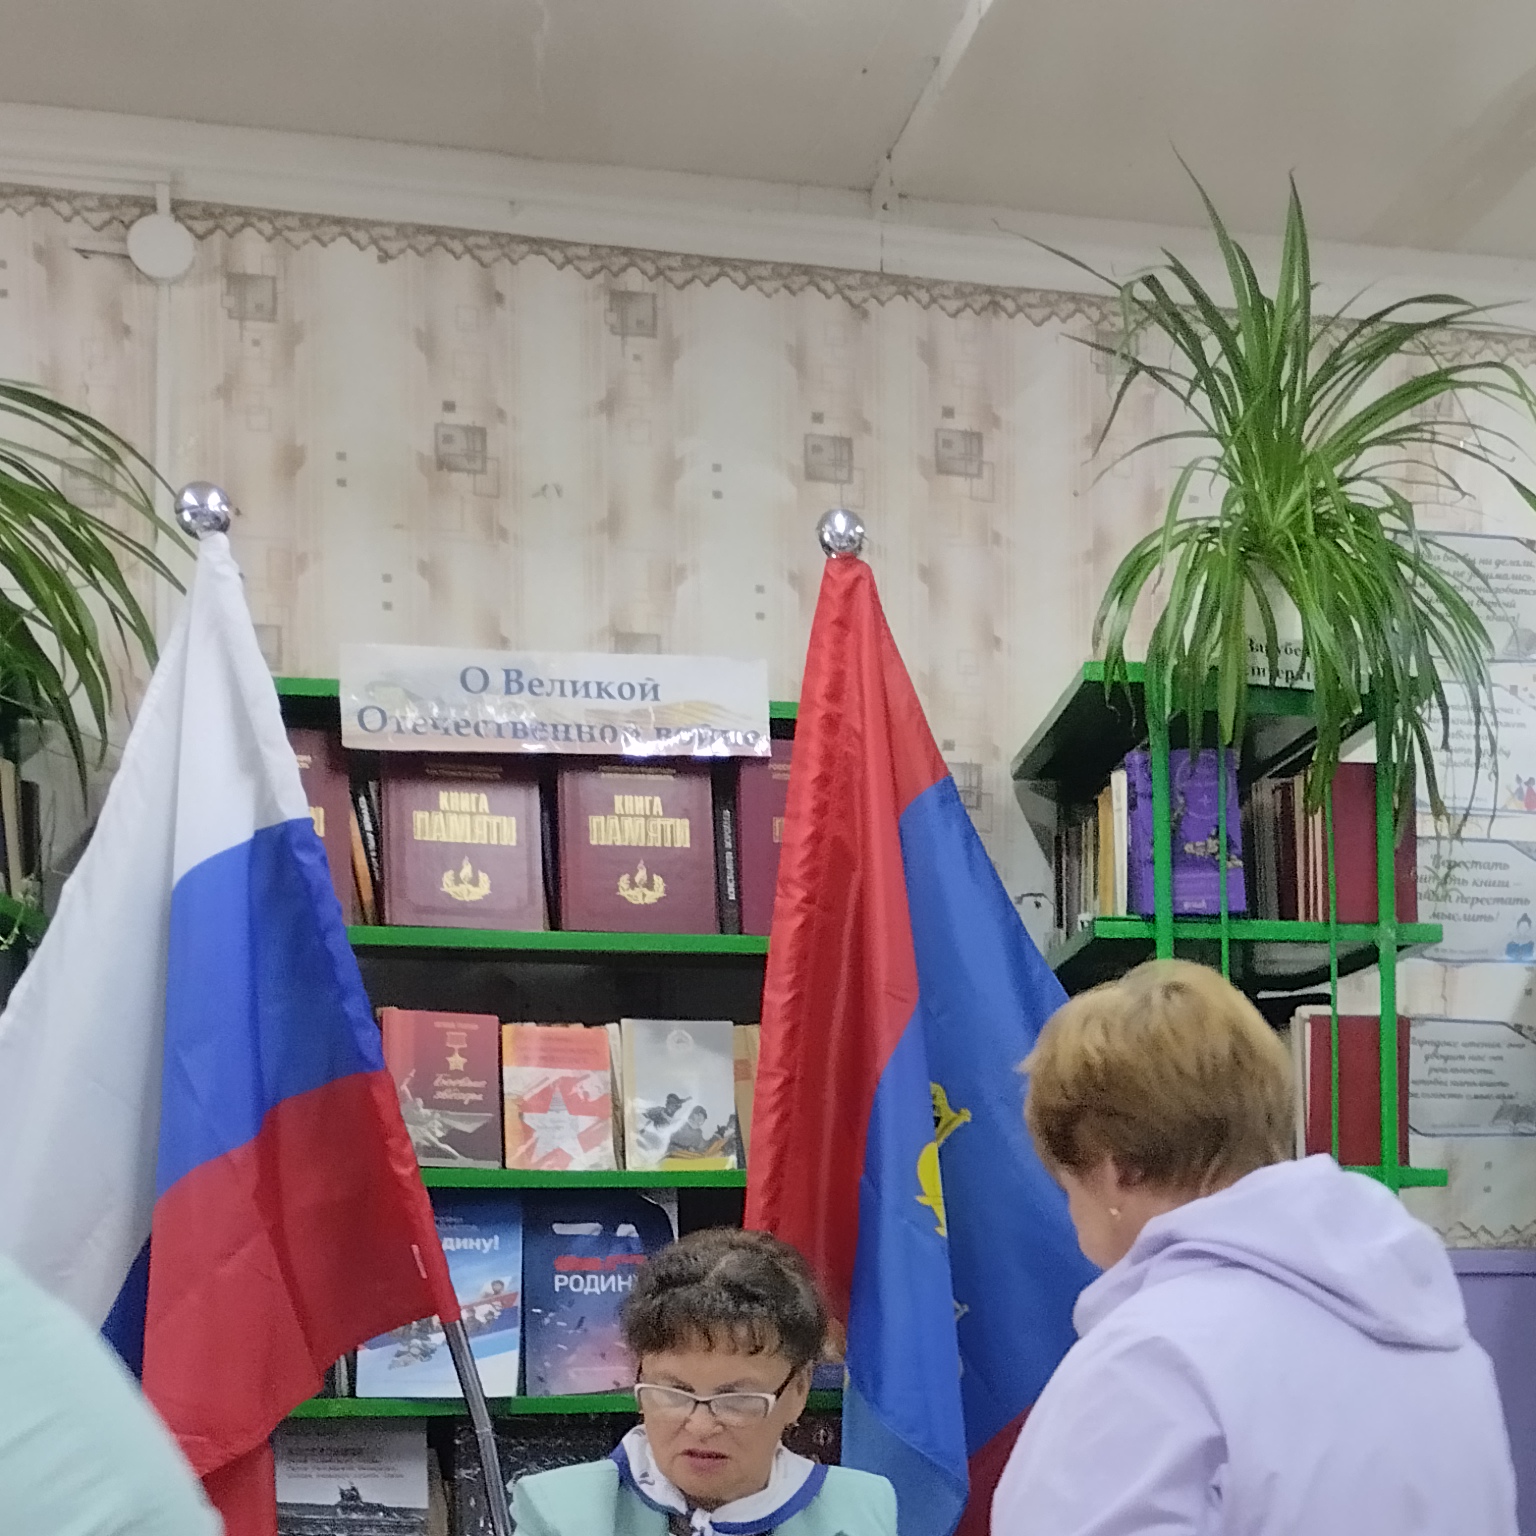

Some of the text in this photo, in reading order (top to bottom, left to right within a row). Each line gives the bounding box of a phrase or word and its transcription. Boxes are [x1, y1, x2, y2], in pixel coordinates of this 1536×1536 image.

[460, 665, 662, 702] О Великой
[439, 790, 490, 813] КНИГА
[613, 794, 664, 816] КНИГА
[412, 810, 517, 847] ПАМЯТИ
[588, 815, 691, 848] ПАМЯТИ
[441, 1234, 500, 1254] дину!
